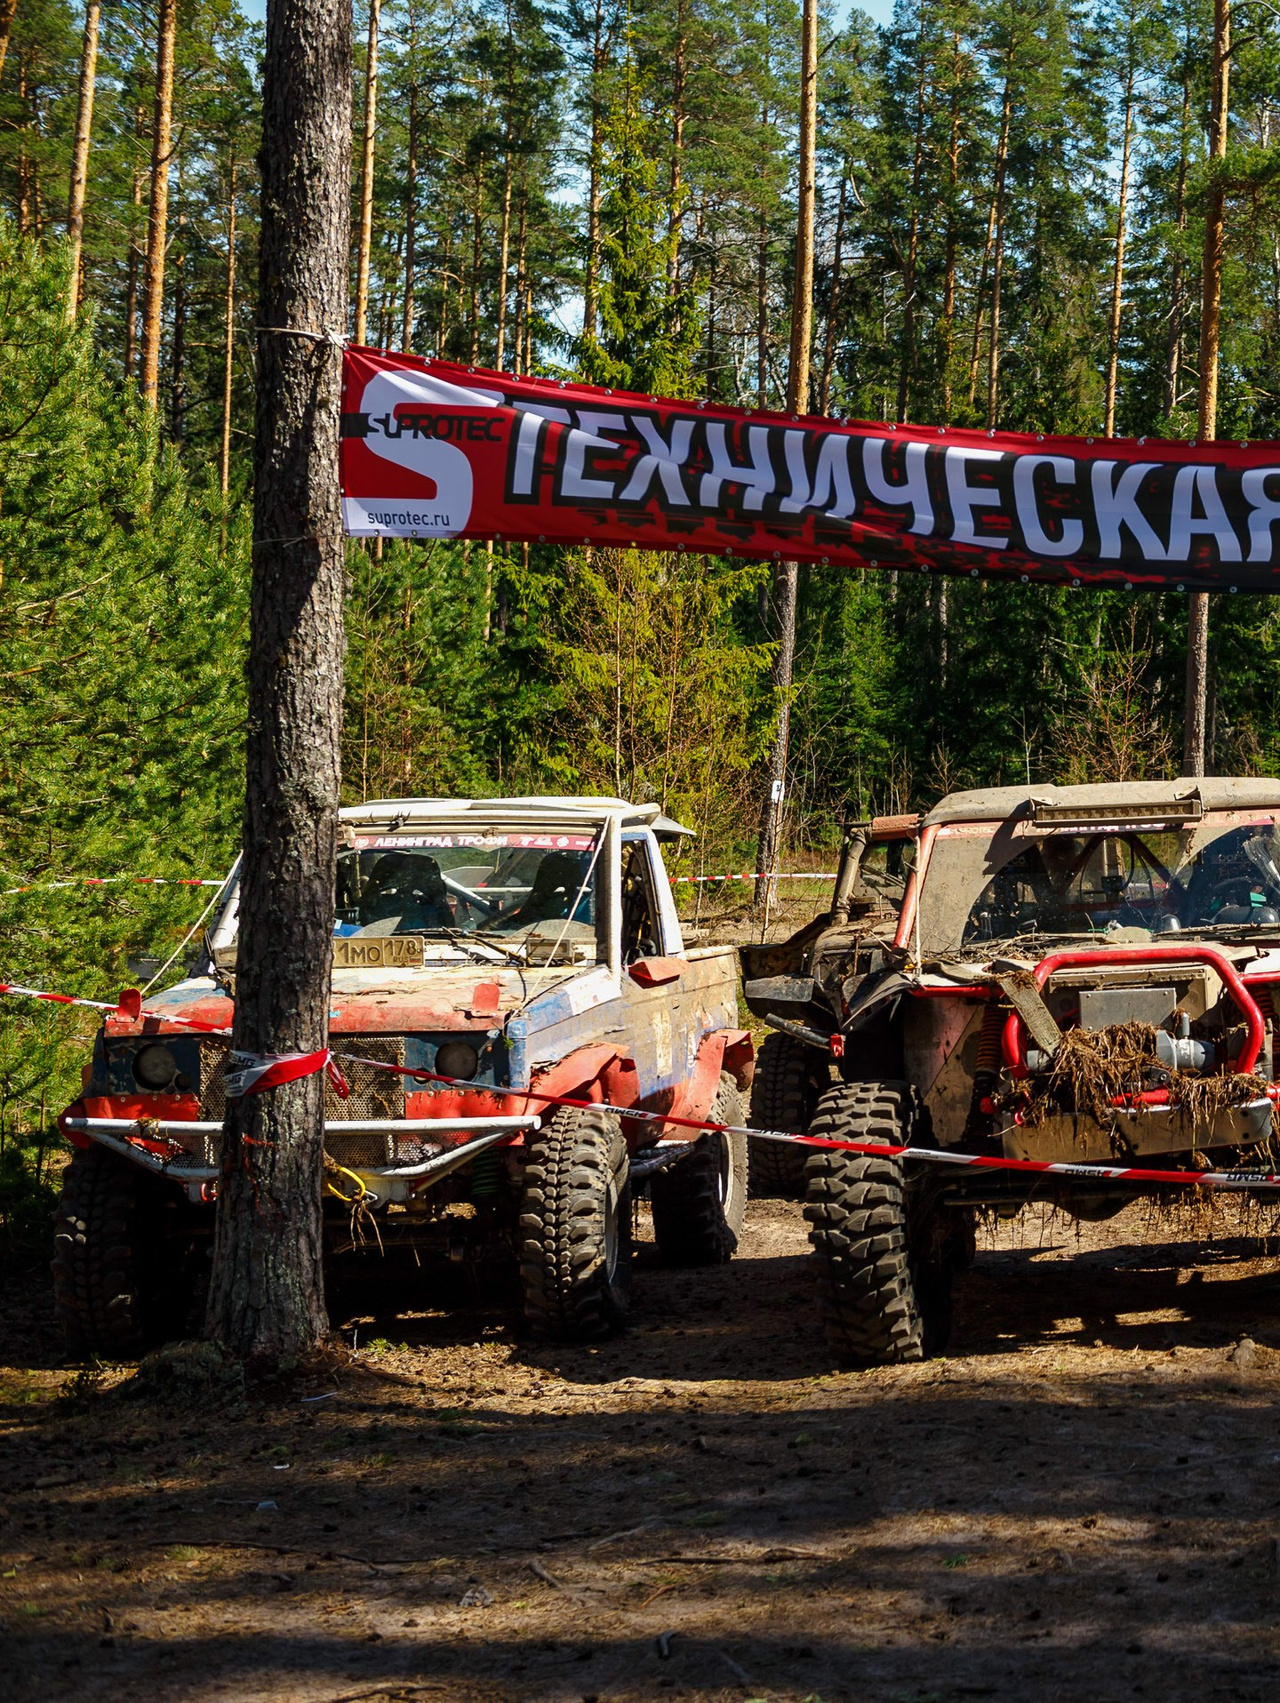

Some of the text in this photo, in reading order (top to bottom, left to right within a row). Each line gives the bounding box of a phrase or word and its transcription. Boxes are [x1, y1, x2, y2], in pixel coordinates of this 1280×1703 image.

[367, 412, 505, 442] SUPROTEC
[367, 510, 450, 528] suprotec.ru
[374, 836, 453, 848] ЛЕНИНГРАД
[457, 835, 509, 847] ТРОФИ
[385, 939, 417, 956] 178
